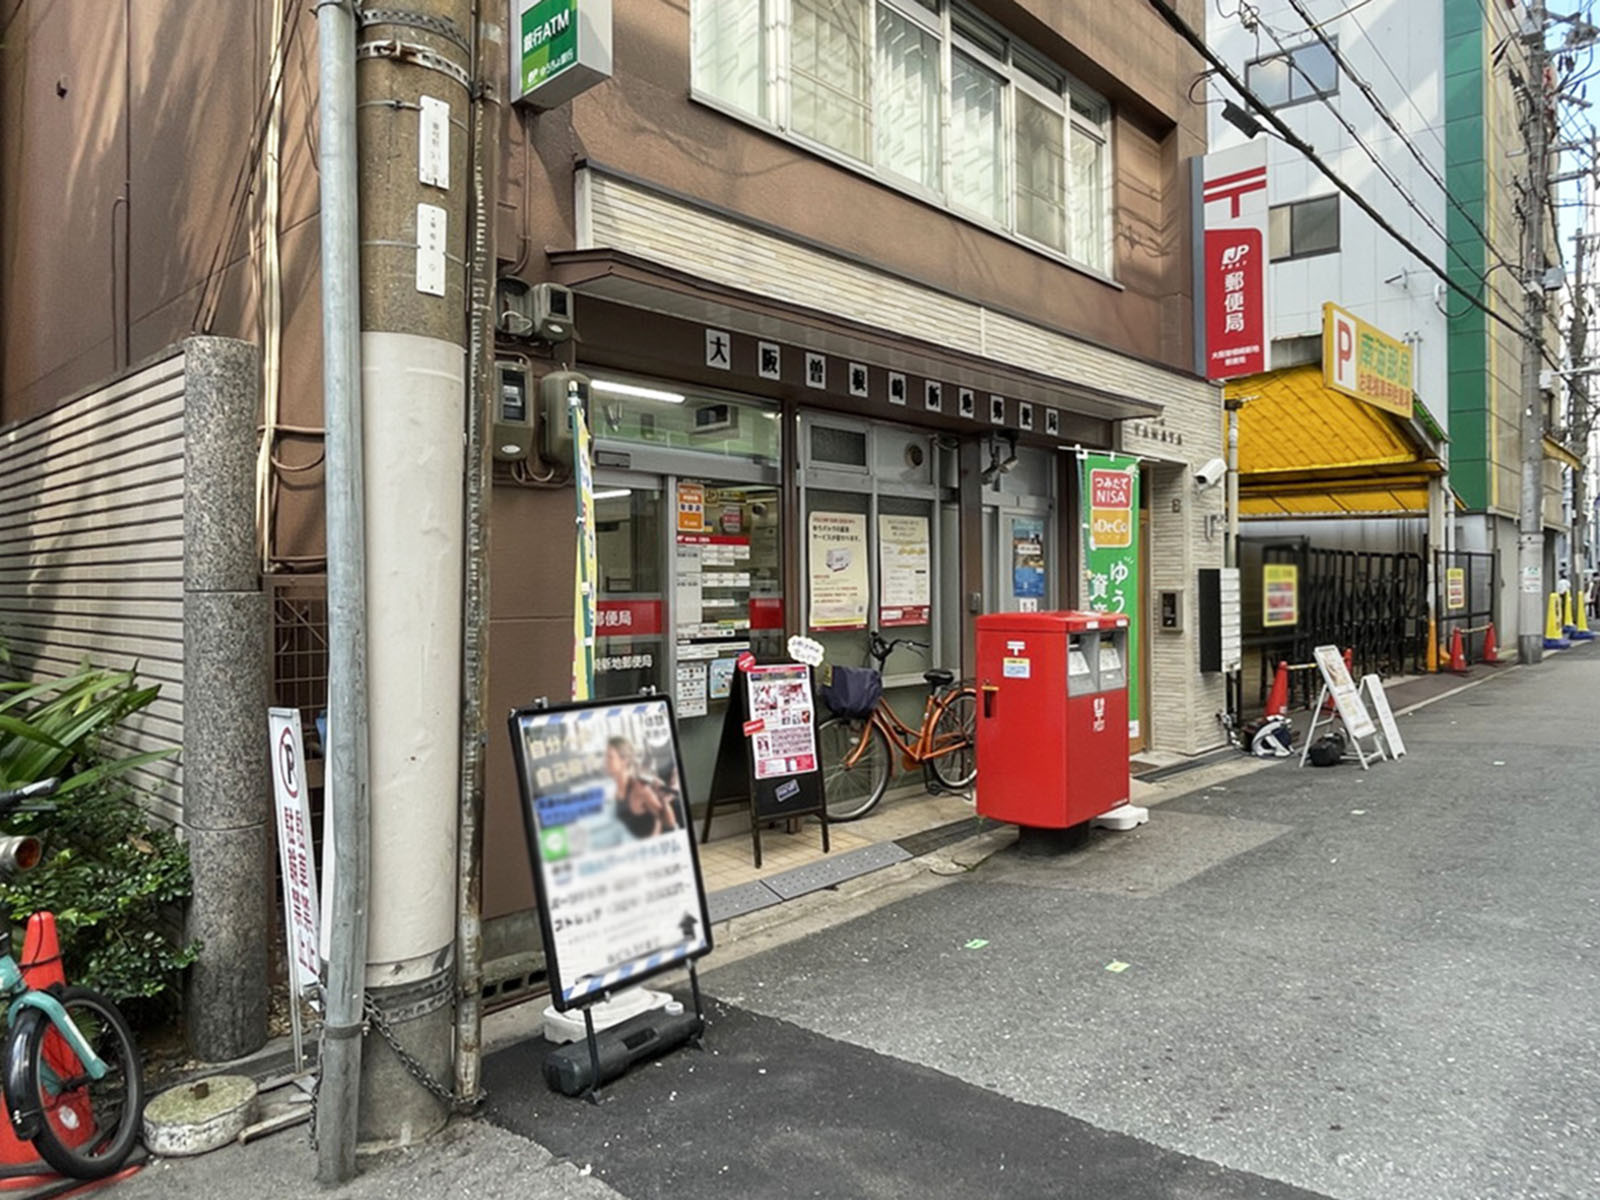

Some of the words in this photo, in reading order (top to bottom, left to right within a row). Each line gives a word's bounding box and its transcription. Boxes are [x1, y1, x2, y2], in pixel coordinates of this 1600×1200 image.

[523, 8, 570, 54] 銀行ATM
[1224, 270, 1244, 334] 郵便局
[1338, 319, 1352, 381] P
[1095, 477, 1129, 490] つみたて
[1095, 489, 1128, 504] NISA
[1094, 518, 1129, 533] iDeCo
